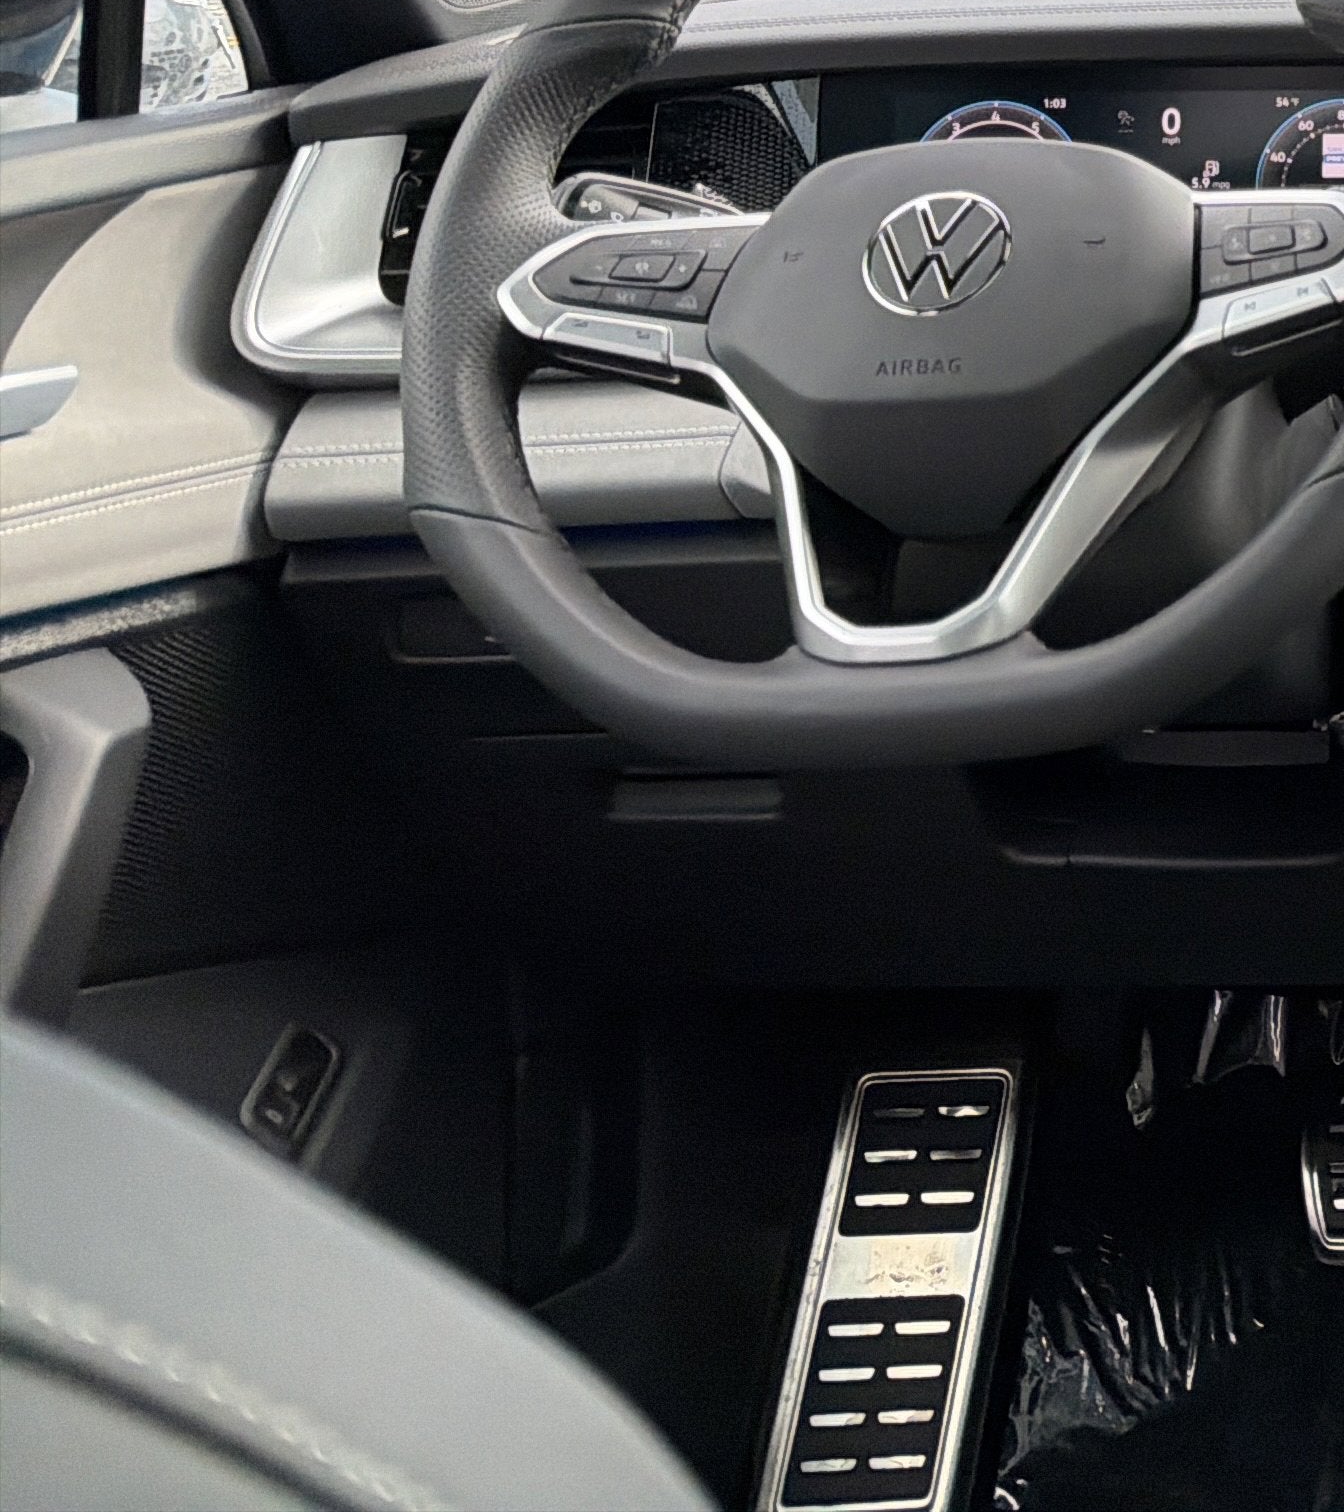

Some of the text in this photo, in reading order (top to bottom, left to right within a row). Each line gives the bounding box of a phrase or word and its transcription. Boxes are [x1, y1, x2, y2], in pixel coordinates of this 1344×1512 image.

[1043, 98, 1067, 109] 1:03
[1275, 96, 1289, 107] 54
[1162, 107, 1181, 135] 0
[1298, 119, 1314, 131] 60
[952, 122, 961, 134] 3
[1031, 122, 1040, 134] 5
[1270, 151, 1286, 163] 40
[875, 357, 962, 377] AIRBAG
